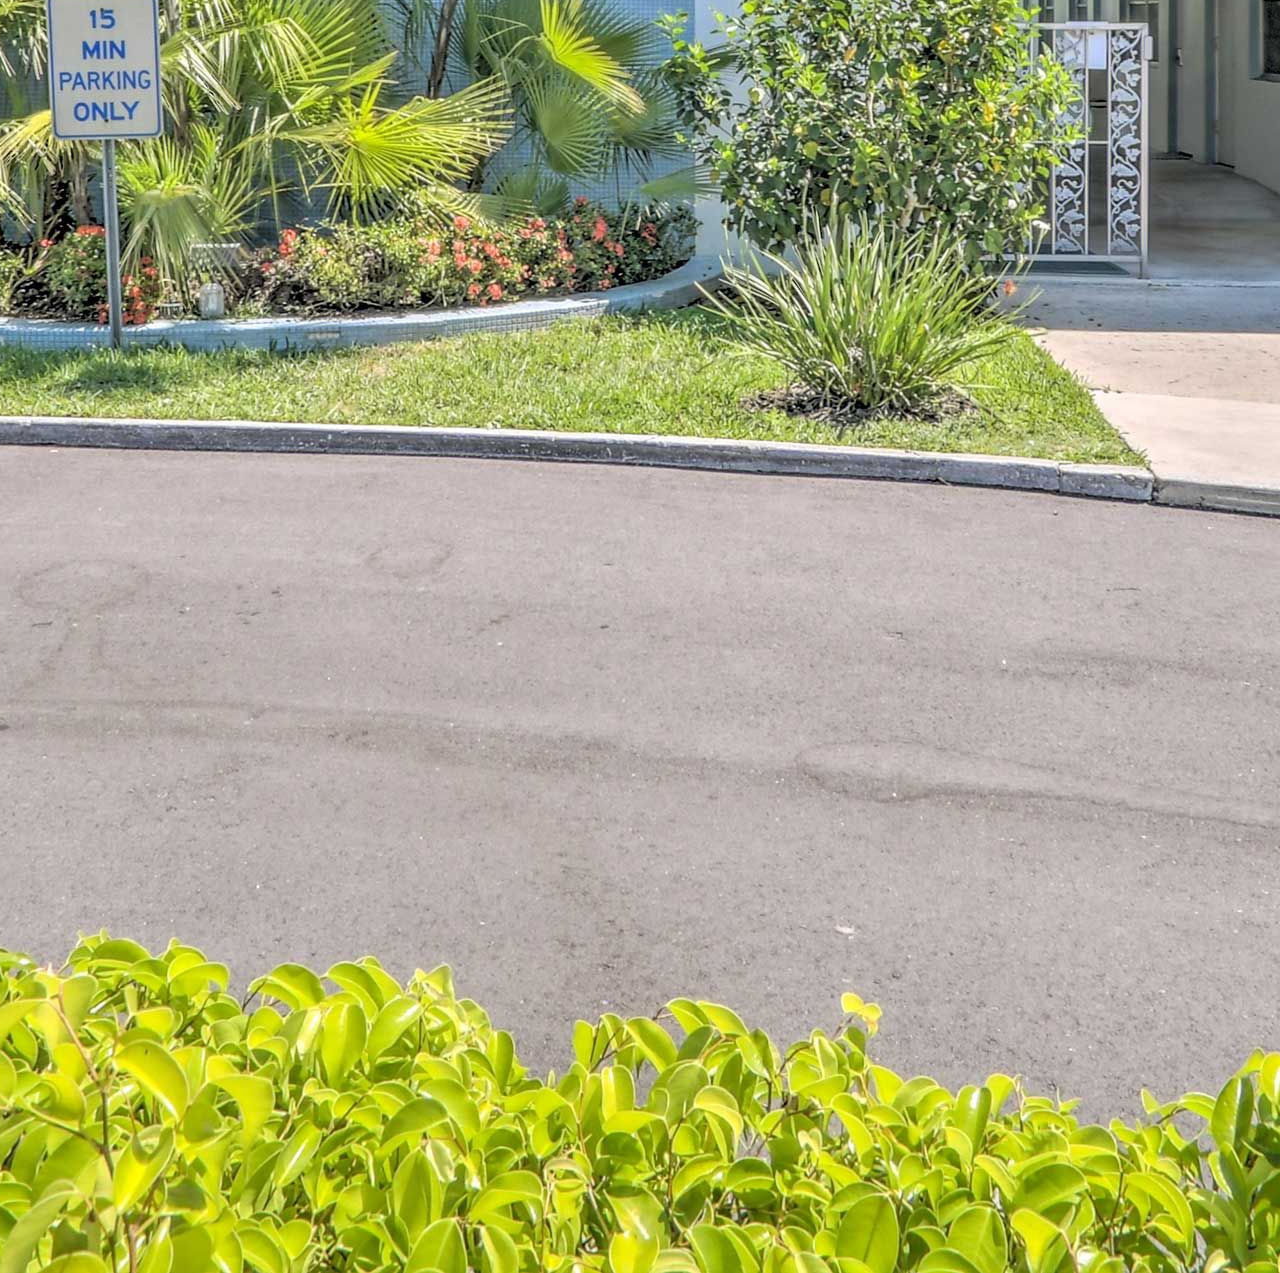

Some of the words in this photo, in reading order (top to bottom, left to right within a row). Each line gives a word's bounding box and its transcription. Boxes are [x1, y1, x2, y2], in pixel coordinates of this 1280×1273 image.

[89, 9, 116, 29] 15
[82, 40, 126, 60] MIN
[59, 70, 151, 91] PARKING
[73, 101, 140, 122] ONLY
